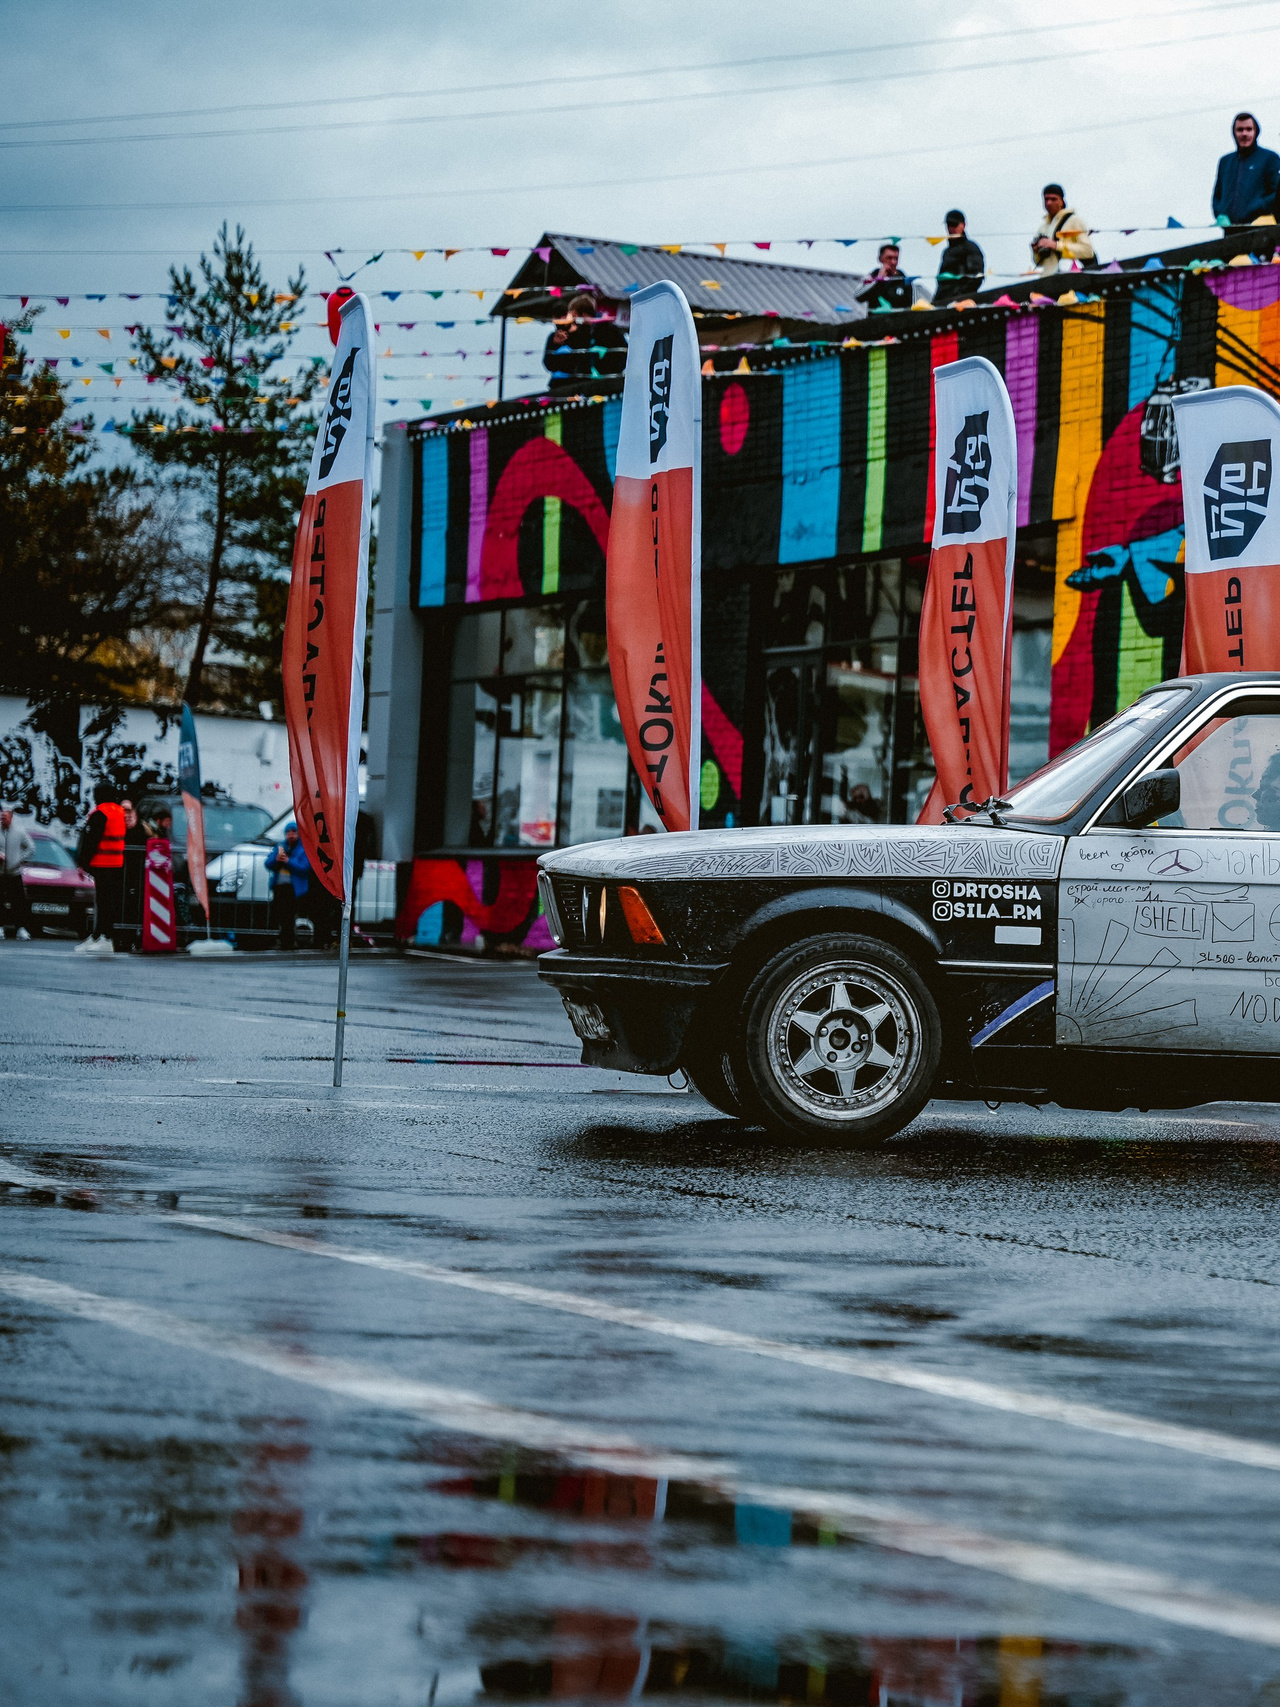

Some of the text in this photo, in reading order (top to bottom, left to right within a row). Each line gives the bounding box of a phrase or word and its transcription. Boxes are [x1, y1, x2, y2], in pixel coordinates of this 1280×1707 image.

[953, 882, 1042, 900] DRTOSHA
[953, 902, 1042, 920] SILA_P.M
[1140, 906, 1201, 932] SHELL
